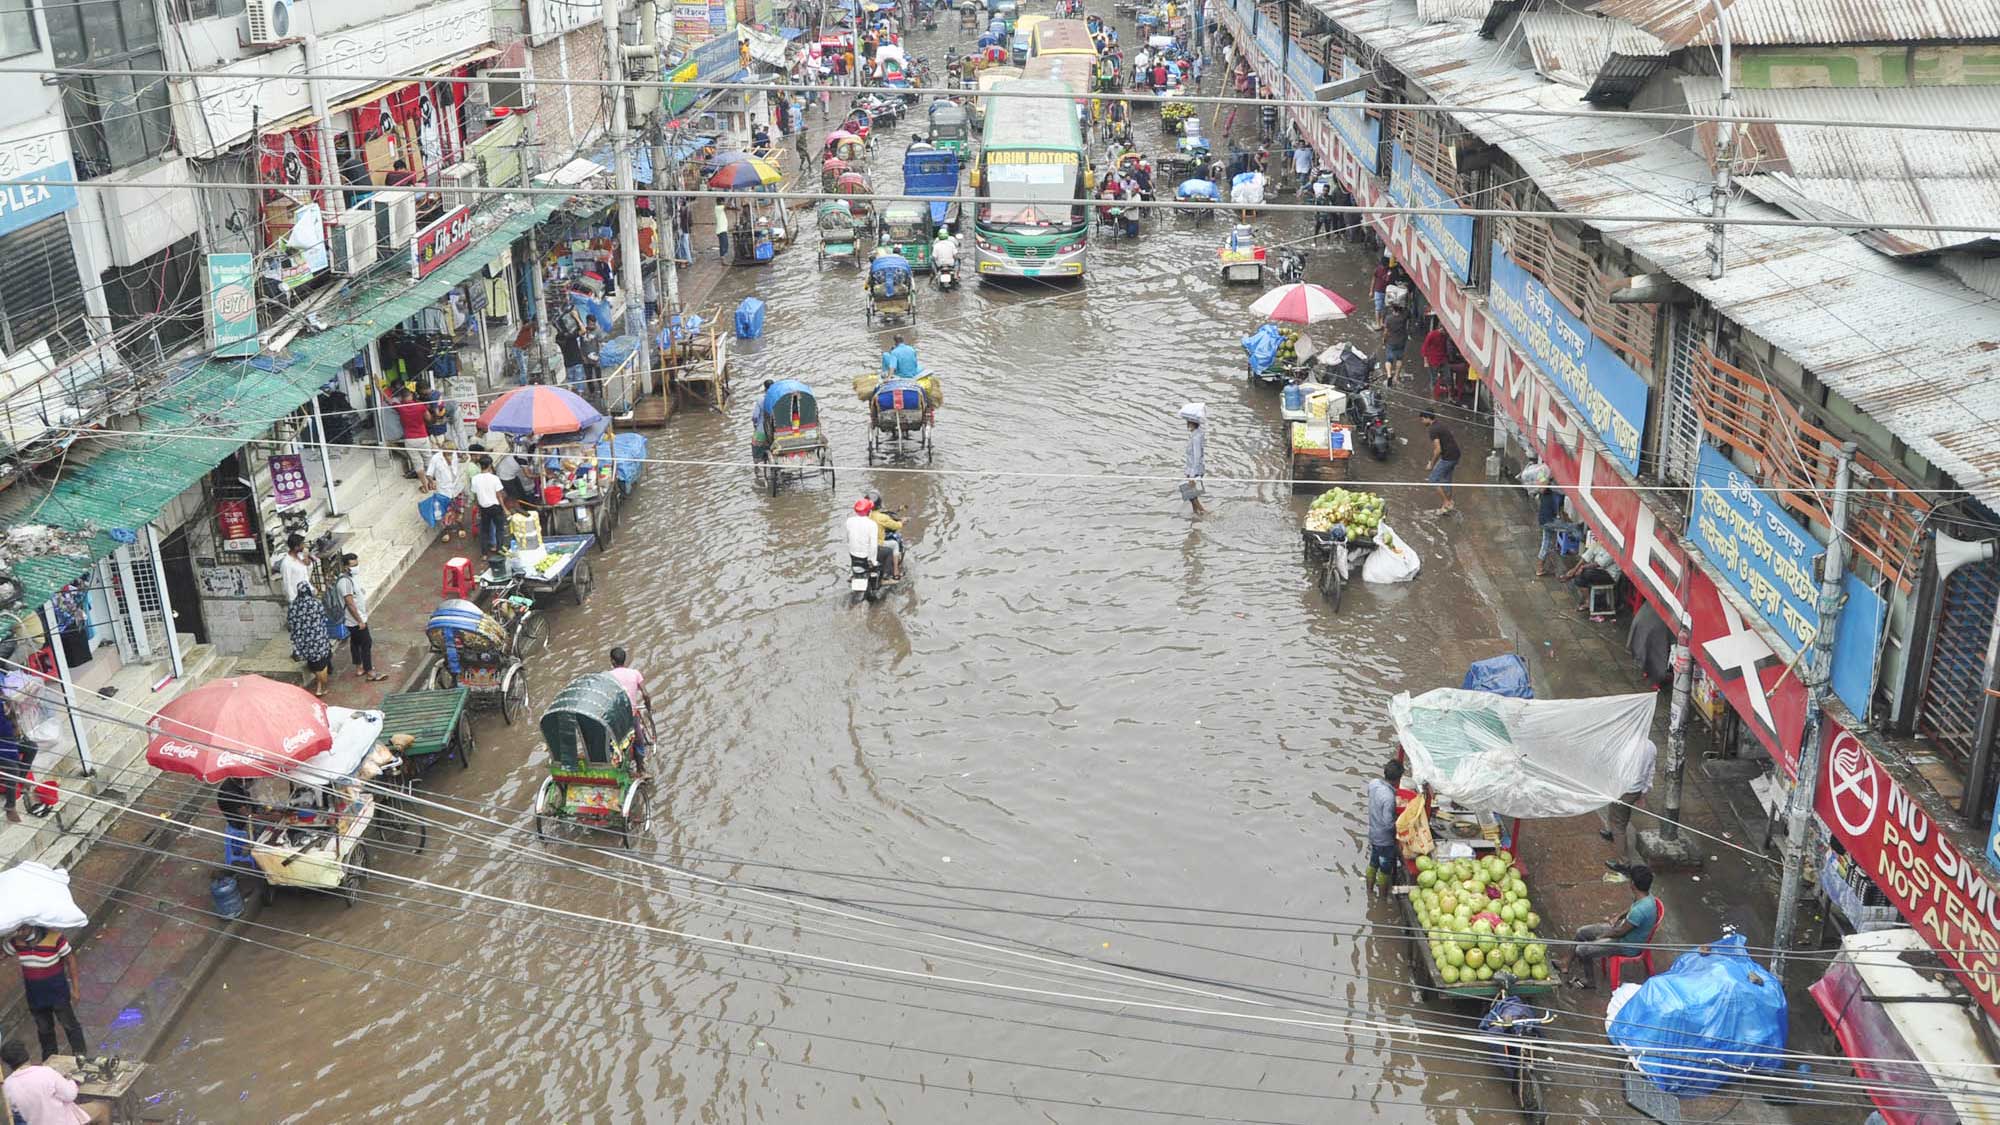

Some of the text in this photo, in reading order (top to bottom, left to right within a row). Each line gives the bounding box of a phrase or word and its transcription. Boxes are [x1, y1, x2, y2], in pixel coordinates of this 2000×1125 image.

[987, 151, 1078, 164] KARIM MOTORS
[1700, 514, 1739, 572] পাইকারী
[1728, 472, 1806, 557] দ্বিতীয় তলায়
[160, 741, 198, 759] Coca-Cola
[1888, 782, 1928, 842] NO
[1879, 850, 1923, 910] NOT
[1884, 820, 1998, 966] POSTERS
